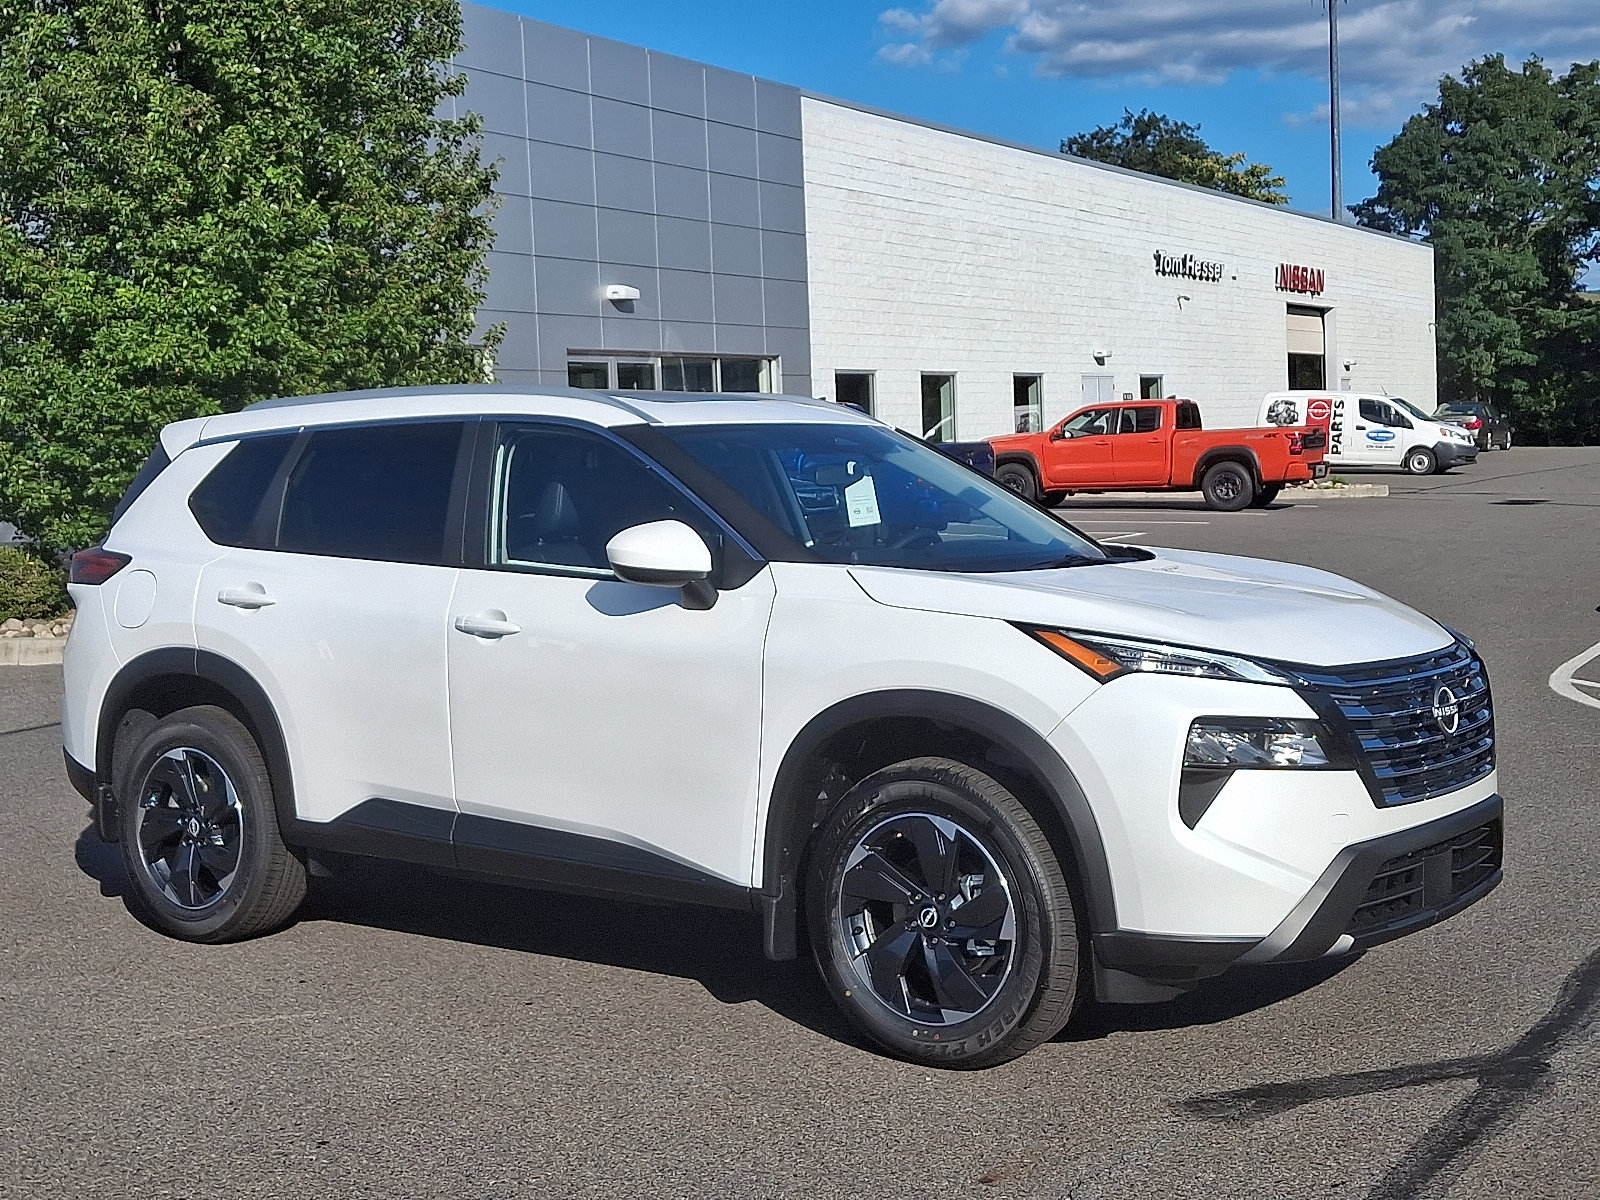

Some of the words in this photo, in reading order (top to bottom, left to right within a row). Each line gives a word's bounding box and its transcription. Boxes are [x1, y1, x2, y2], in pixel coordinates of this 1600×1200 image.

[1154, 249, 1184, 276] Tom
[1185, 253, 1225, 280] Hesser
[1279, 262, 1325, 293] NISSAN
[1331, 400, 1345, 455] PARTS
